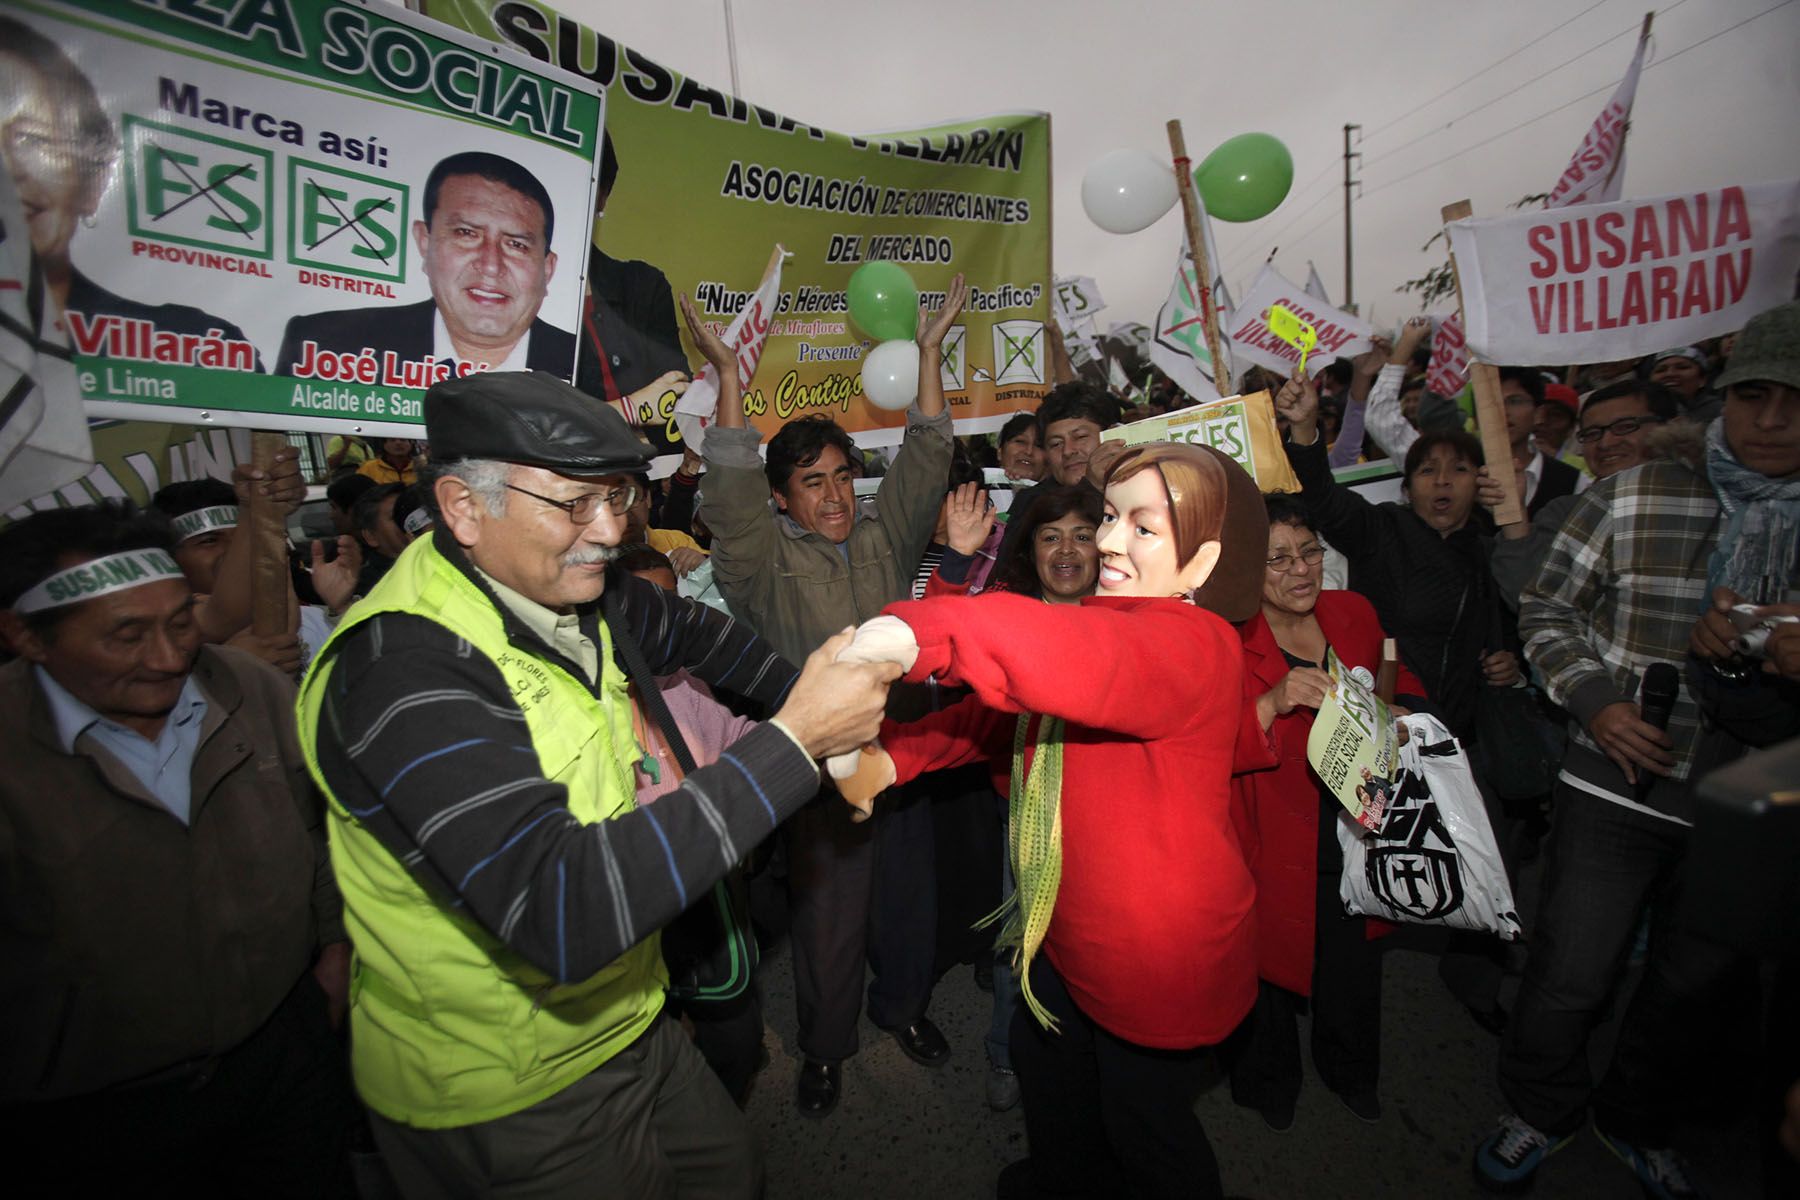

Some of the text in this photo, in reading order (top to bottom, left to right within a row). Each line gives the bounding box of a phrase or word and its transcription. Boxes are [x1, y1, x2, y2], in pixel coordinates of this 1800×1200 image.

[323, 7, 583, 148] SOCIAL
[159, 76, 389, 168] Marca así:
[143, 144, 264, 234] FS
[722, 161, 1030, 223] ASOCIACIÓN DE COMERCIANTES
[303, 183, 397, 262] FS
[1528, 187, 1752, 279] SUSANA
[132, 241, 272, 279] PROVINCIAL
[826, 235, 952, 263] DEL MERCADO
[299, 271, 396, 298] DISTRITAL
[794, 287, 849, 312] Héroes
[1058, 285, 1088, 314] FS
[1528, 248, 1752, 336] VILLARAN
[65, 311, 256, 372] Villarán
[785, 320, 845, 338] Miraflores
[107, 368, 177, 399] Lima
[293, 341, 377, 385] José
[383, 350, 449, 390] Luis
[292, 384, 422, 417] Alcalde de San
[775, 370, 863, 418] Contigo
[46, 555, 149, 601] SUSANA
[1328, 728, 1363, 796] FUERZA SOCIAL
